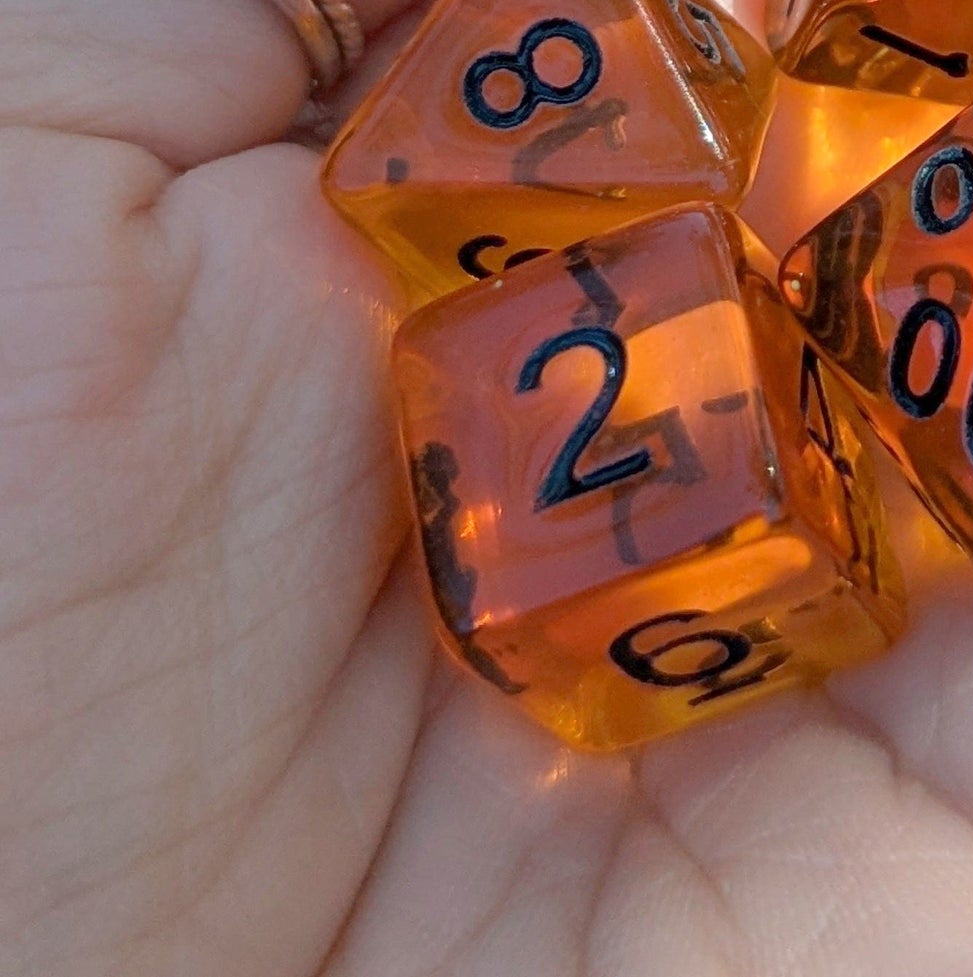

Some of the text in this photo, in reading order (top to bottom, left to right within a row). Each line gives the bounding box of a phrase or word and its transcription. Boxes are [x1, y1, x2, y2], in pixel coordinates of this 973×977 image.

[463, 18, 603, 130] 8
[858, 25, 970, 78] 1
[515, 325, 653, 514] 2
